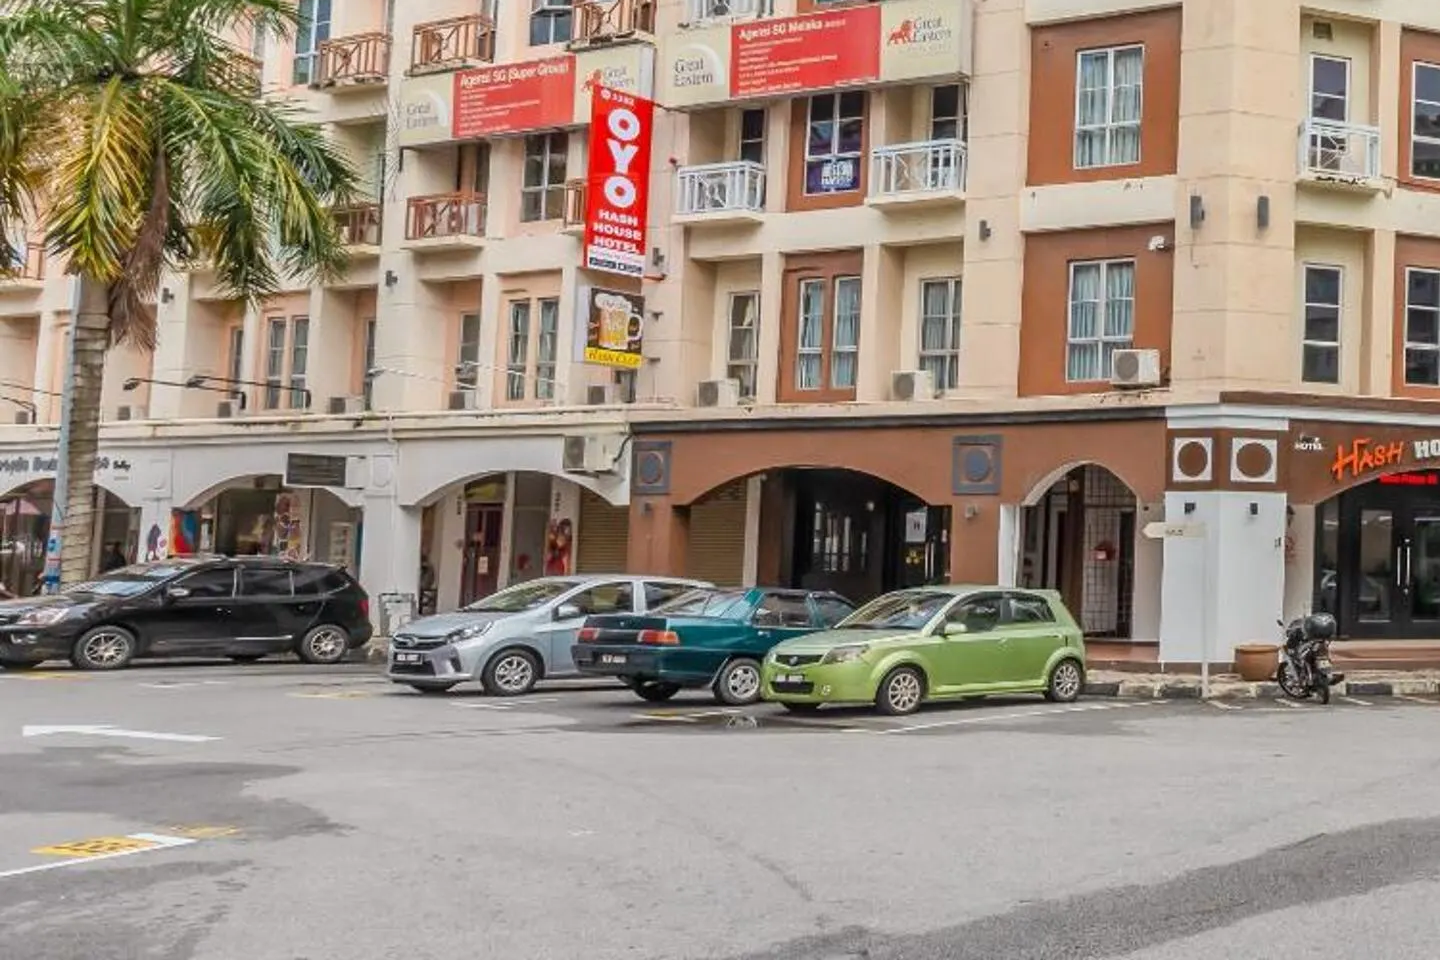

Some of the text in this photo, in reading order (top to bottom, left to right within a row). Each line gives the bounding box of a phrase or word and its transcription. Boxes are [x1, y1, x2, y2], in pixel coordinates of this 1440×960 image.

[788, 19, 823, 34] Melaka
[912, 16, 943, 31] Great
[674, 58, 704, 73] Great
[604, 108, 641, 208] OYO
[597, 209, 639, 227] HASH
[593, 222, 642, 241] HOUSE
[593, 235, 637, 254] HOTEL
[1329, 436, 1404, 481] HASH
